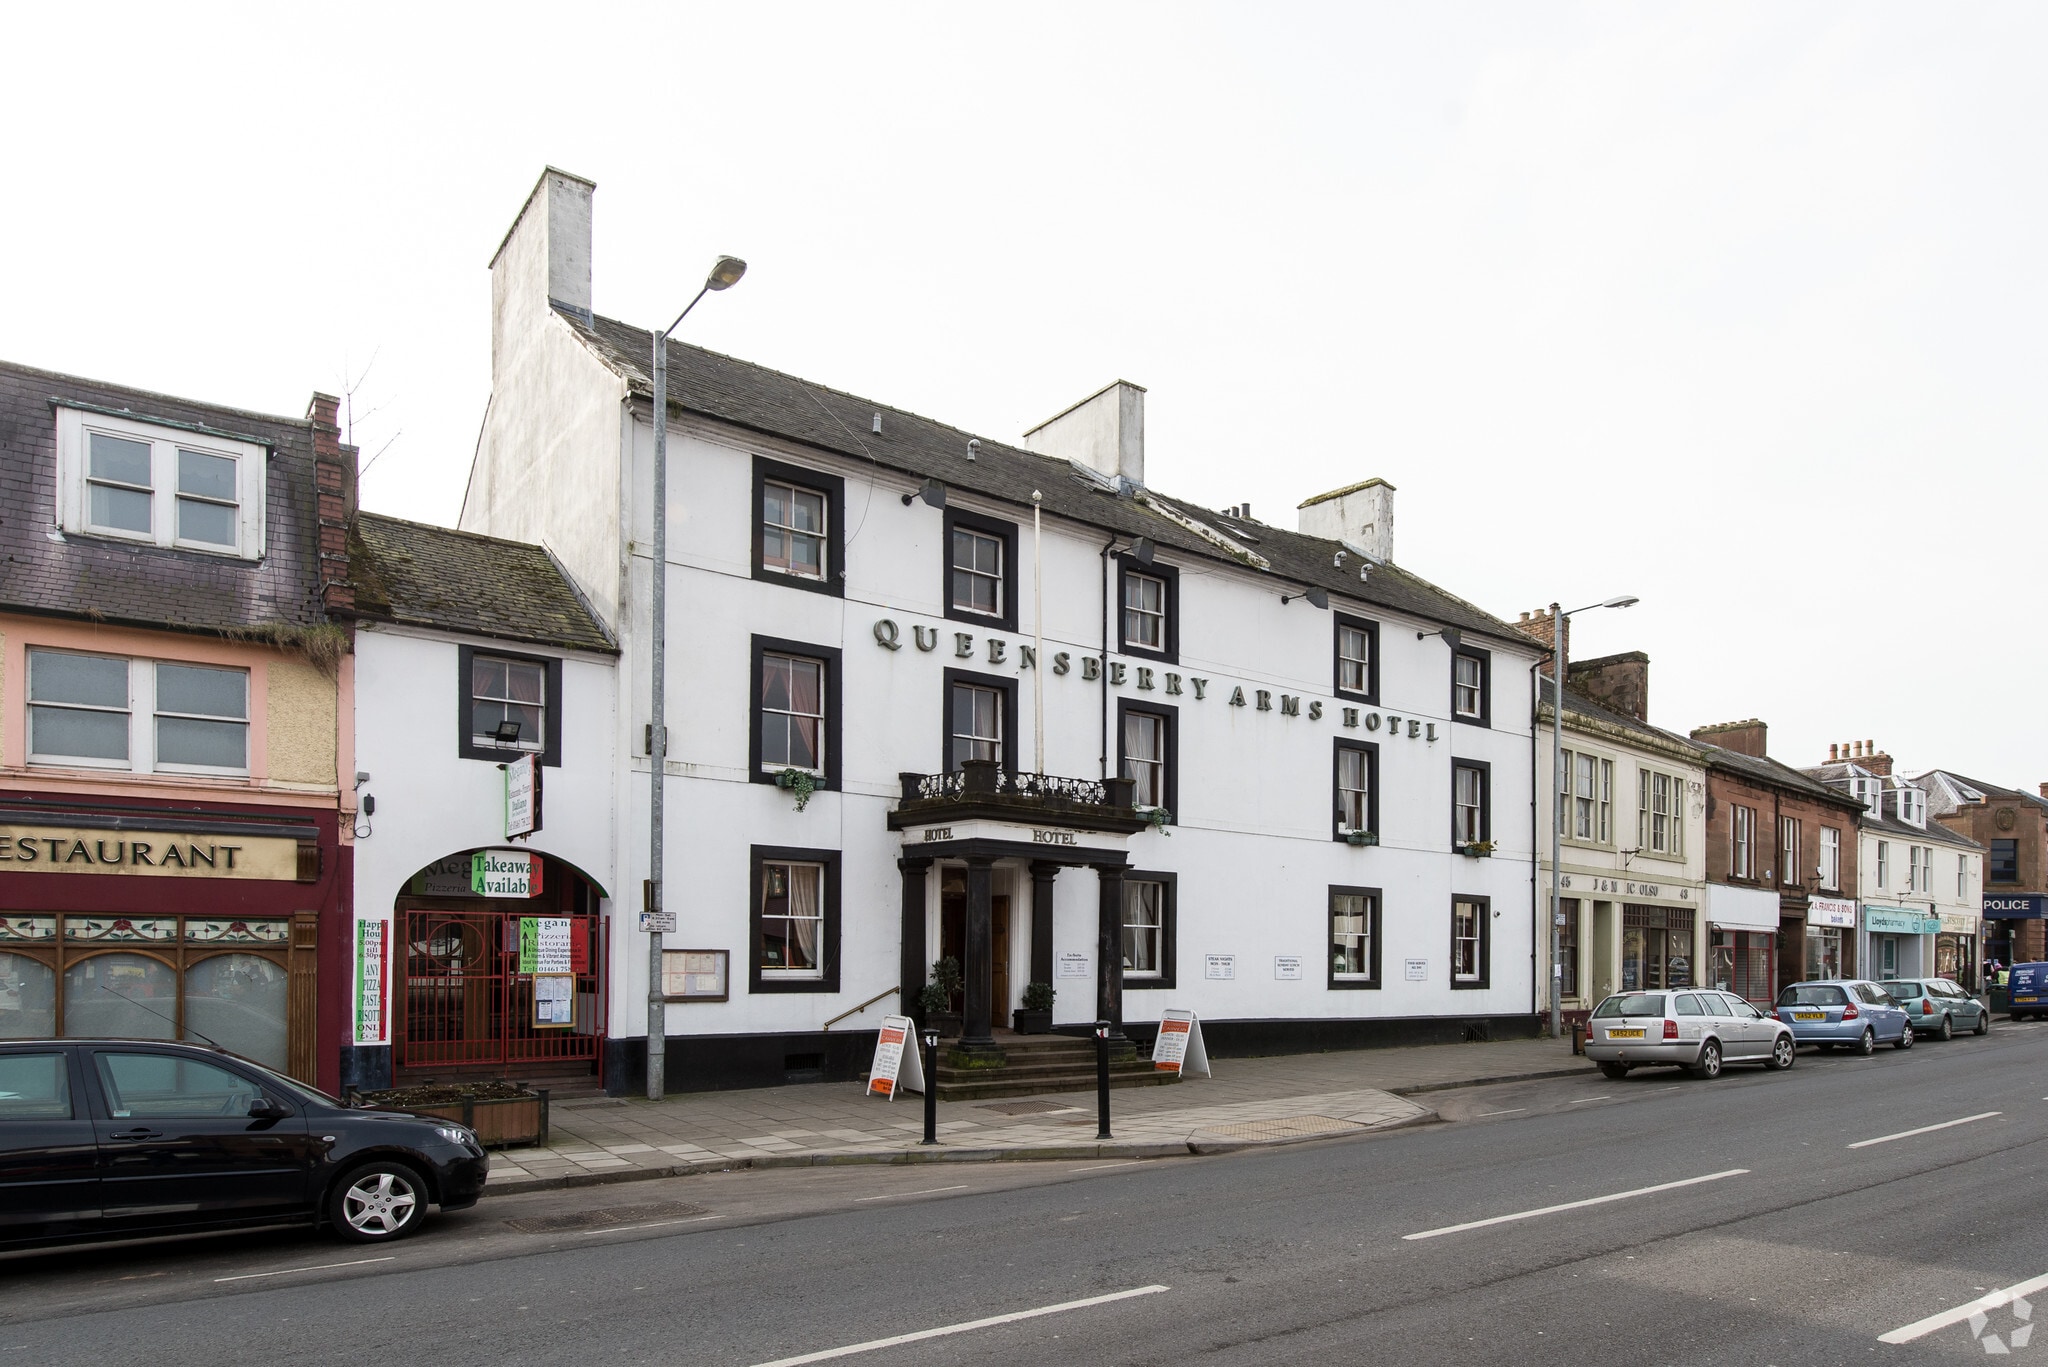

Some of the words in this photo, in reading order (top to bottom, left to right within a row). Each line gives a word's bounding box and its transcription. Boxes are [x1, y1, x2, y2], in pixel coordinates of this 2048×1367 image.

[873, 618, 1209, 700] QUEENSBERRY
[1228, 685, 1323, 721] ARMS
[1342, 707, 1440, 742] HOTEL
[924, 827, 954, 842] HOTEL
[1032, 828, 1078, 846] HOTEL
[0, 835, 243, 869] ESTAURANT
[473, 855, 541, 879] Takeaway
[424, 881, 467, 894] Pizzeria
[475, 876, 539, 894] Available
[1819, 901, 1837, 912] FRANCIS
[1983, 900, 2030, 910] POLICE
[359, 920, 387, 930] Happy
[522, 919, 586, 931] Megano's
[1871, 915, 1906, 929] Lloydspharmacy
[362, 929, 384, 938] Hour
[534, 932, 575, 940] Pizzeria
[365, 964, 379, 976] ANY
[357, 1024, 385, 1032] ONLY
